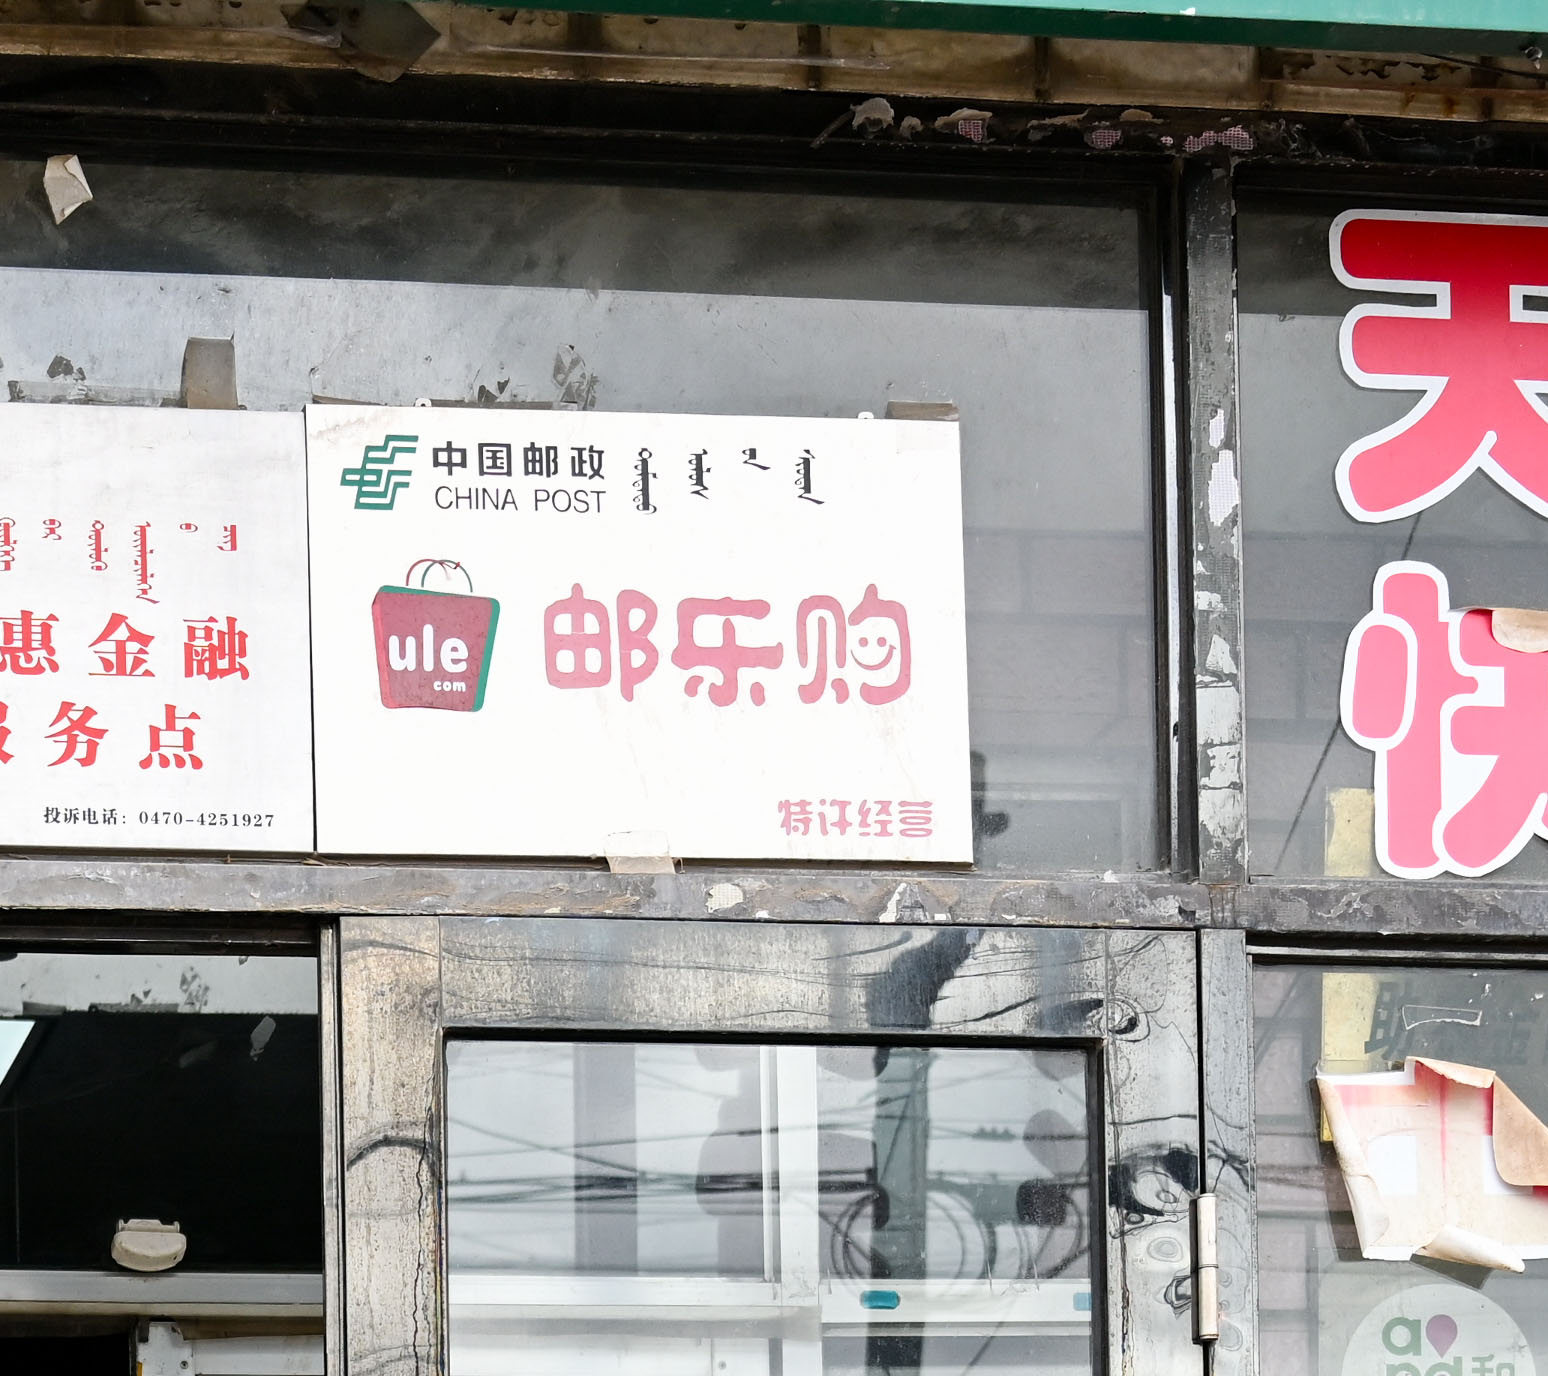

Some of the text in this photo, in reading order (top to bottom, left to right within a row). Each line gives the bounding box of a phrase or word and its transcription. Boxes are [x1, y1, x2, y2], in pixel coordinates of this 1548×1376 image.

[432, 441, 606, 479] 中国邮政
[434, 485, 607, 514] CHINA POST
[388, 624, 468, 673] ule
[543, 582, 912, 707] 邮乐购
[433, 679, 467, 693] com
[139, 810, 275, 828] 0470-4251927
[776, 799, 934, 840] 特许经营
